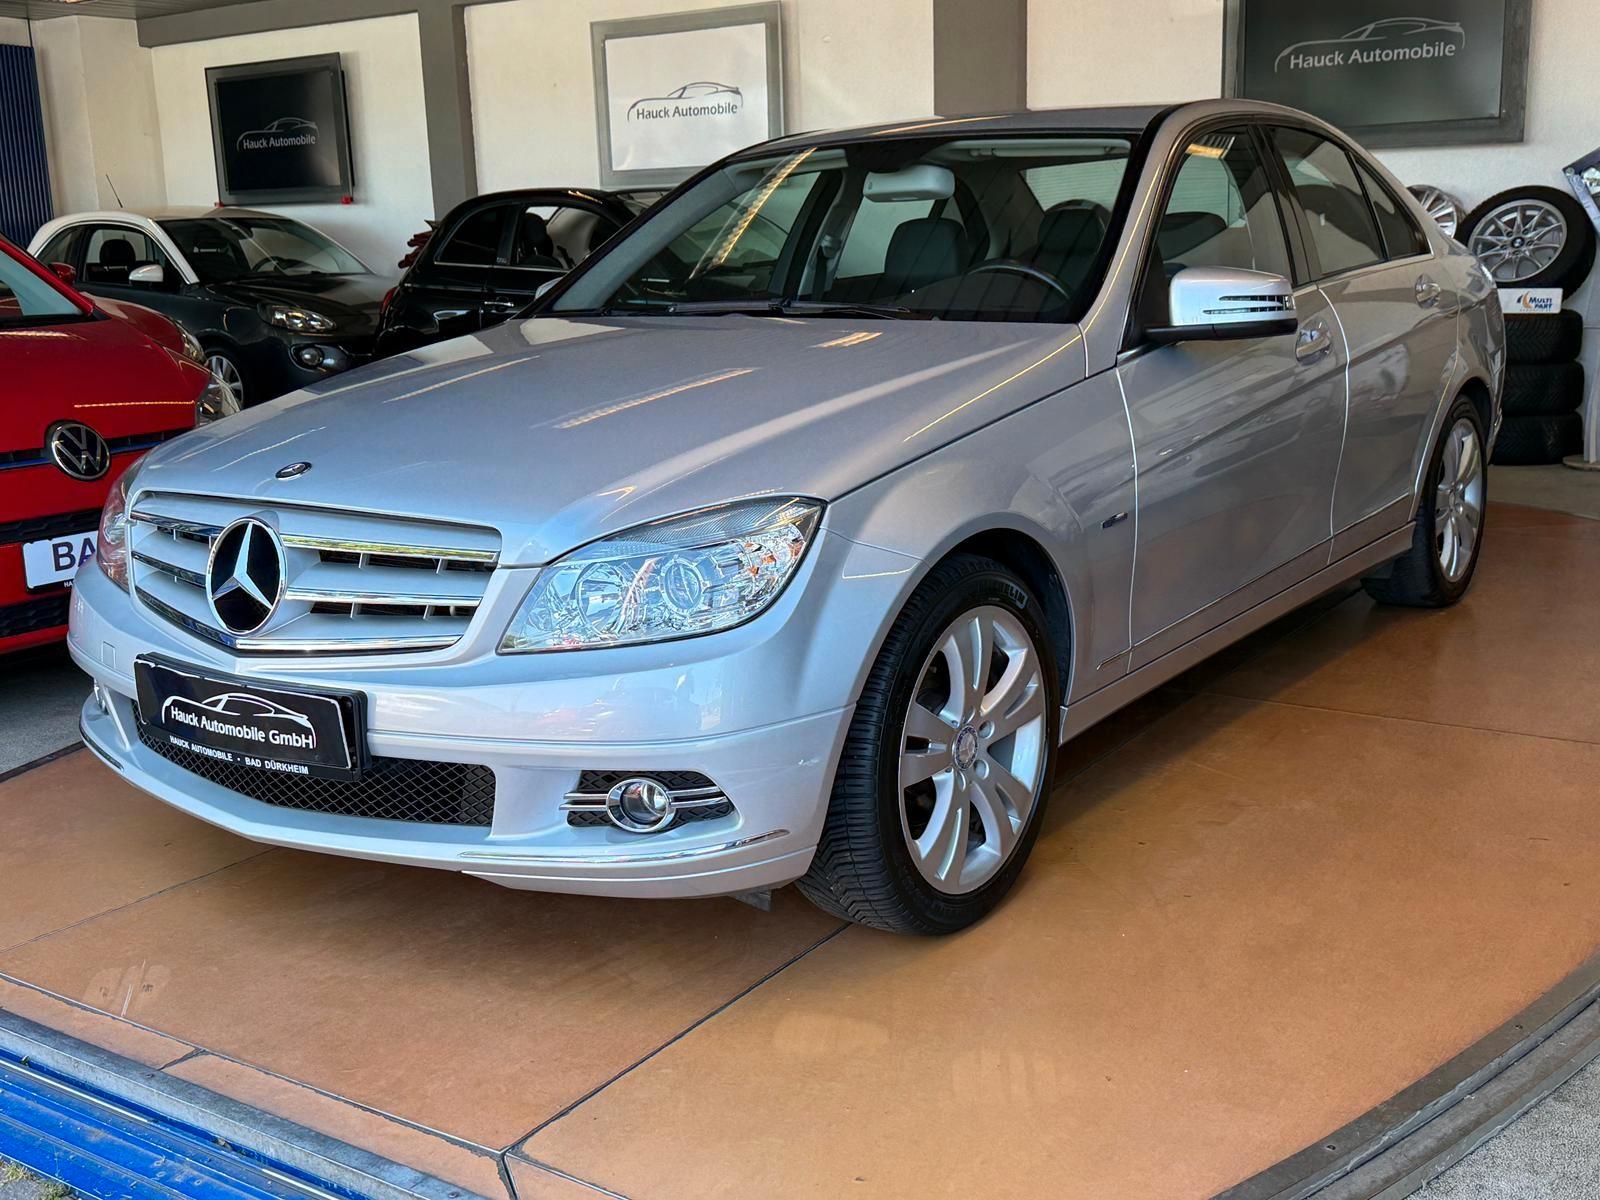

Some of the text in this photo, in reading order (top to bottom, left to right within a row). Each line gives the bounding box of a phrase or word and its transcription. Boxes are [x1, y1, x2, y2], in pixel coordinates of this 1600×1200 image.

[1290, 42, 1456, 69] Hauck Automobile
[636, 103, 738, 120] Hauck Automobile
[243, 135, 316, 149] Hauck Automobile
[170, 705, 314, 749] Hauck Automobile GmbH
[169, 735, 310, 775] HAUCK AUTOMOBILE BAD DÜRKHEIM
